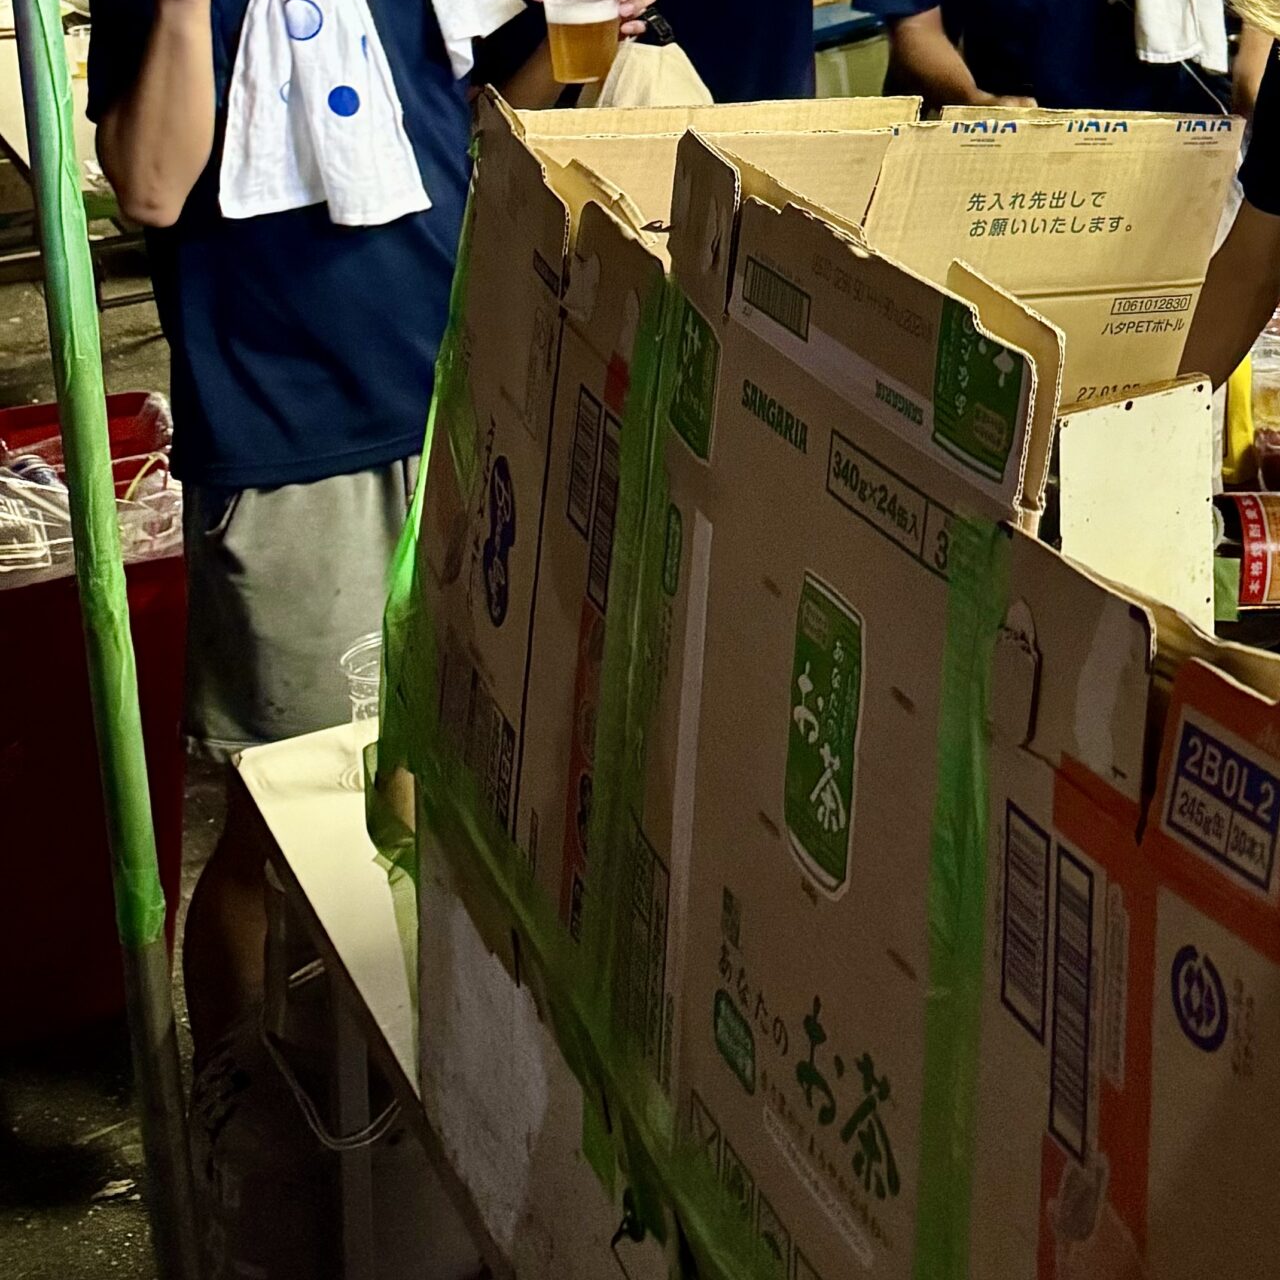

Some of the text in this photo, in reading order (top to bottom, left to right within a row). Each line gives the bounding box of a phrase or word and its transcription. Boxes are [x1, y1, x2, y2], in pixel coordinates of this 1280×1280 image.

[966, 190, 1107, 212] 先入れ先出しで
[969, 216, 1133, 238] お願いいたします。
[1101, 318, 1185, 335] ハタPETボトル
[741, 379, 807, 454] SANGARIA
[796, 994, 900, 1200] お茶
